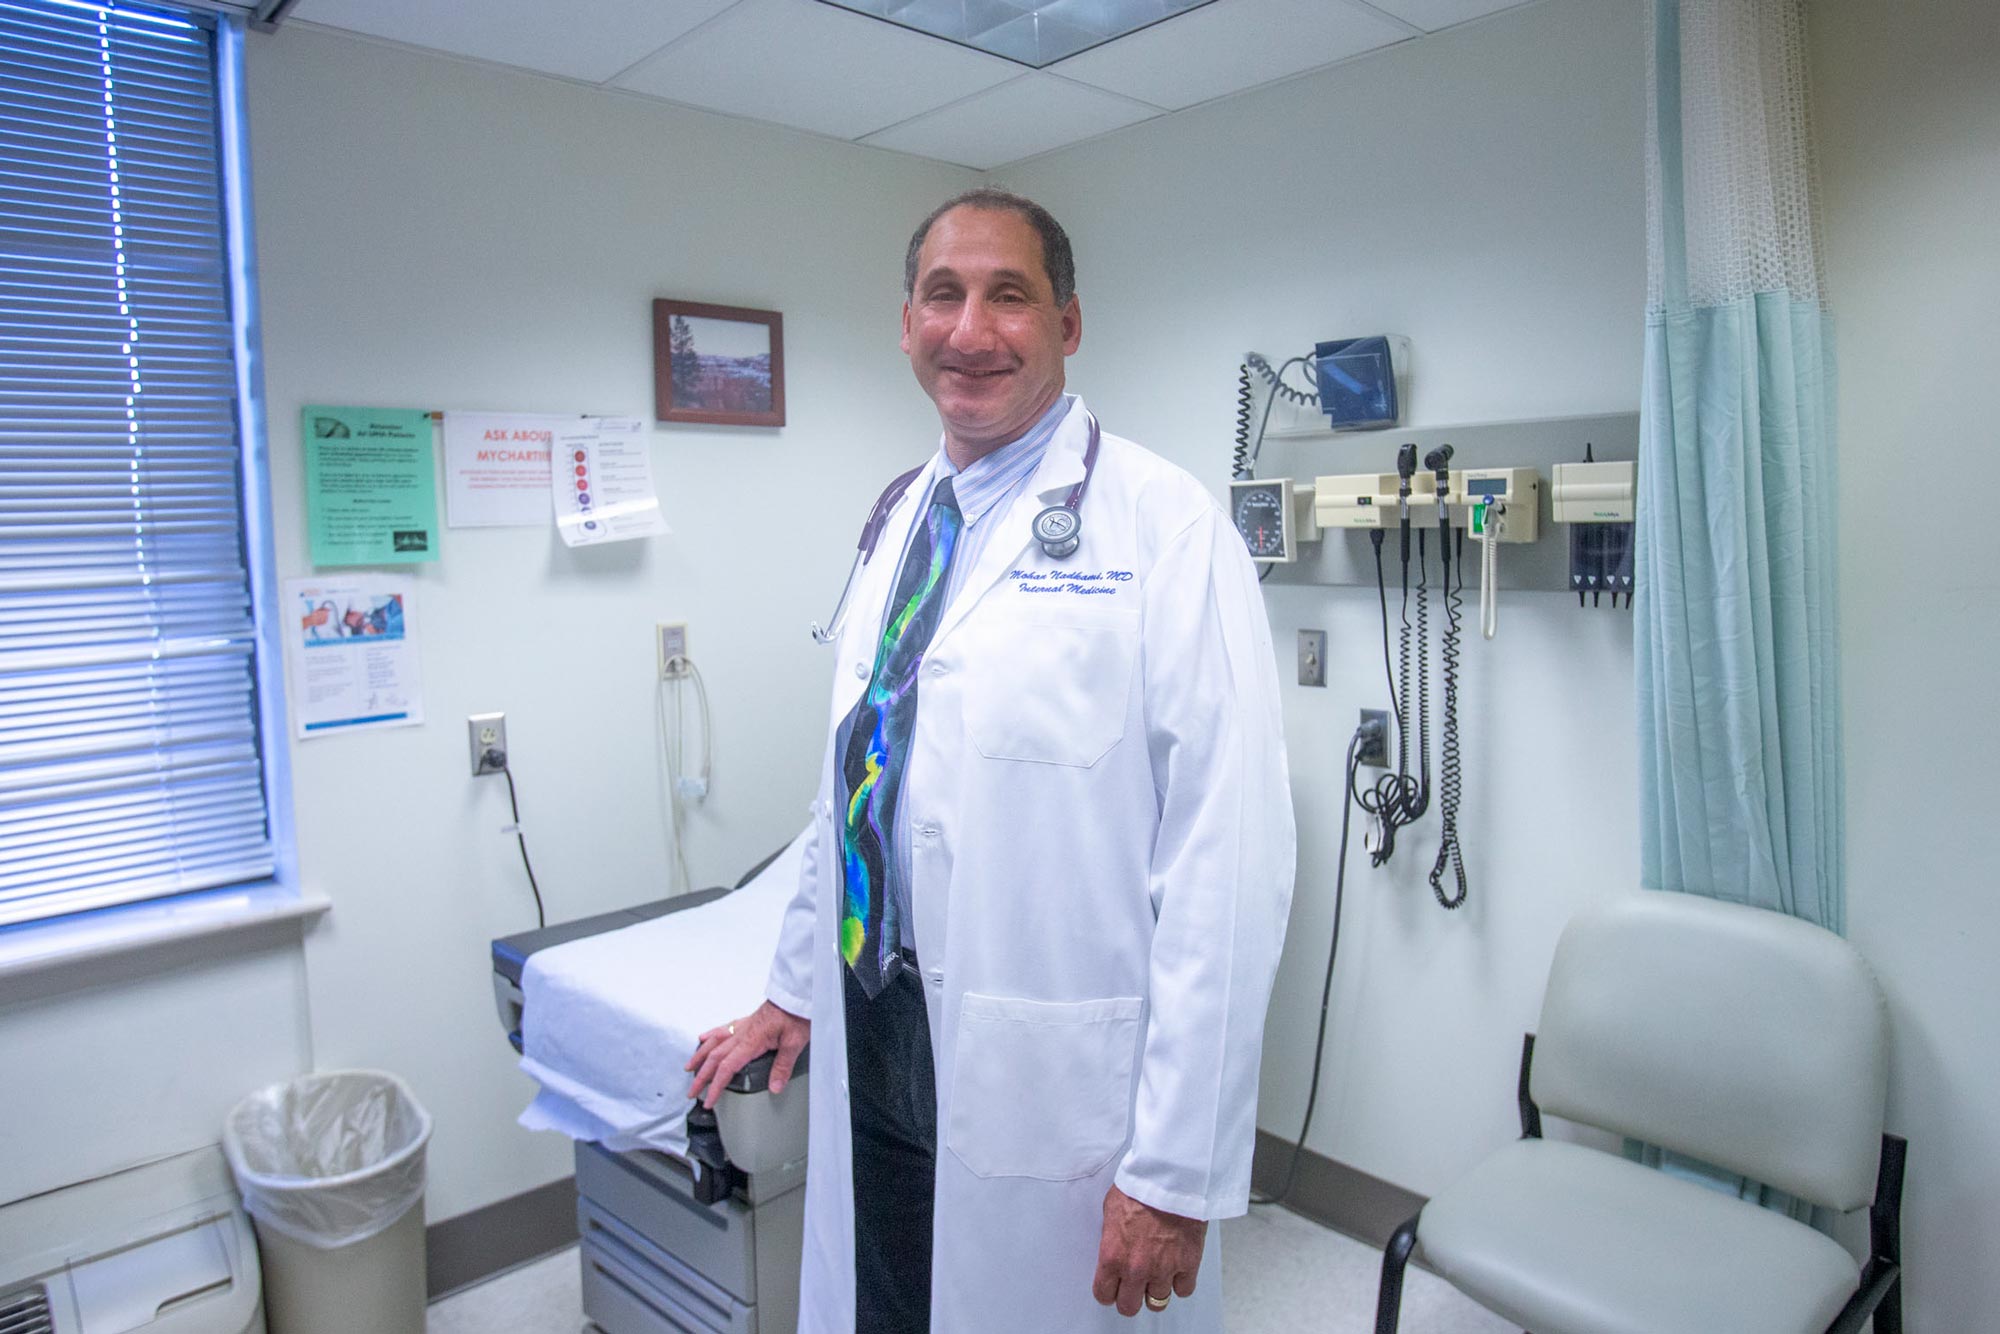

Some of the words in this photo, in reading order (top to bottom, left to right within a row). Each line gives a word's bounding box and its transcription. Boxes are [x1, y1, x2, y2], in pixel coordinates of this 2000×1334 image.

[483, 429, 507, 441] ASK
[1009, 570, 1047, 580] Mohan
[1106, 570, 1134, 582] MD
[1019, 583, 1064, 593] Internal
[1067, 583, 1116, 595] Medicine
